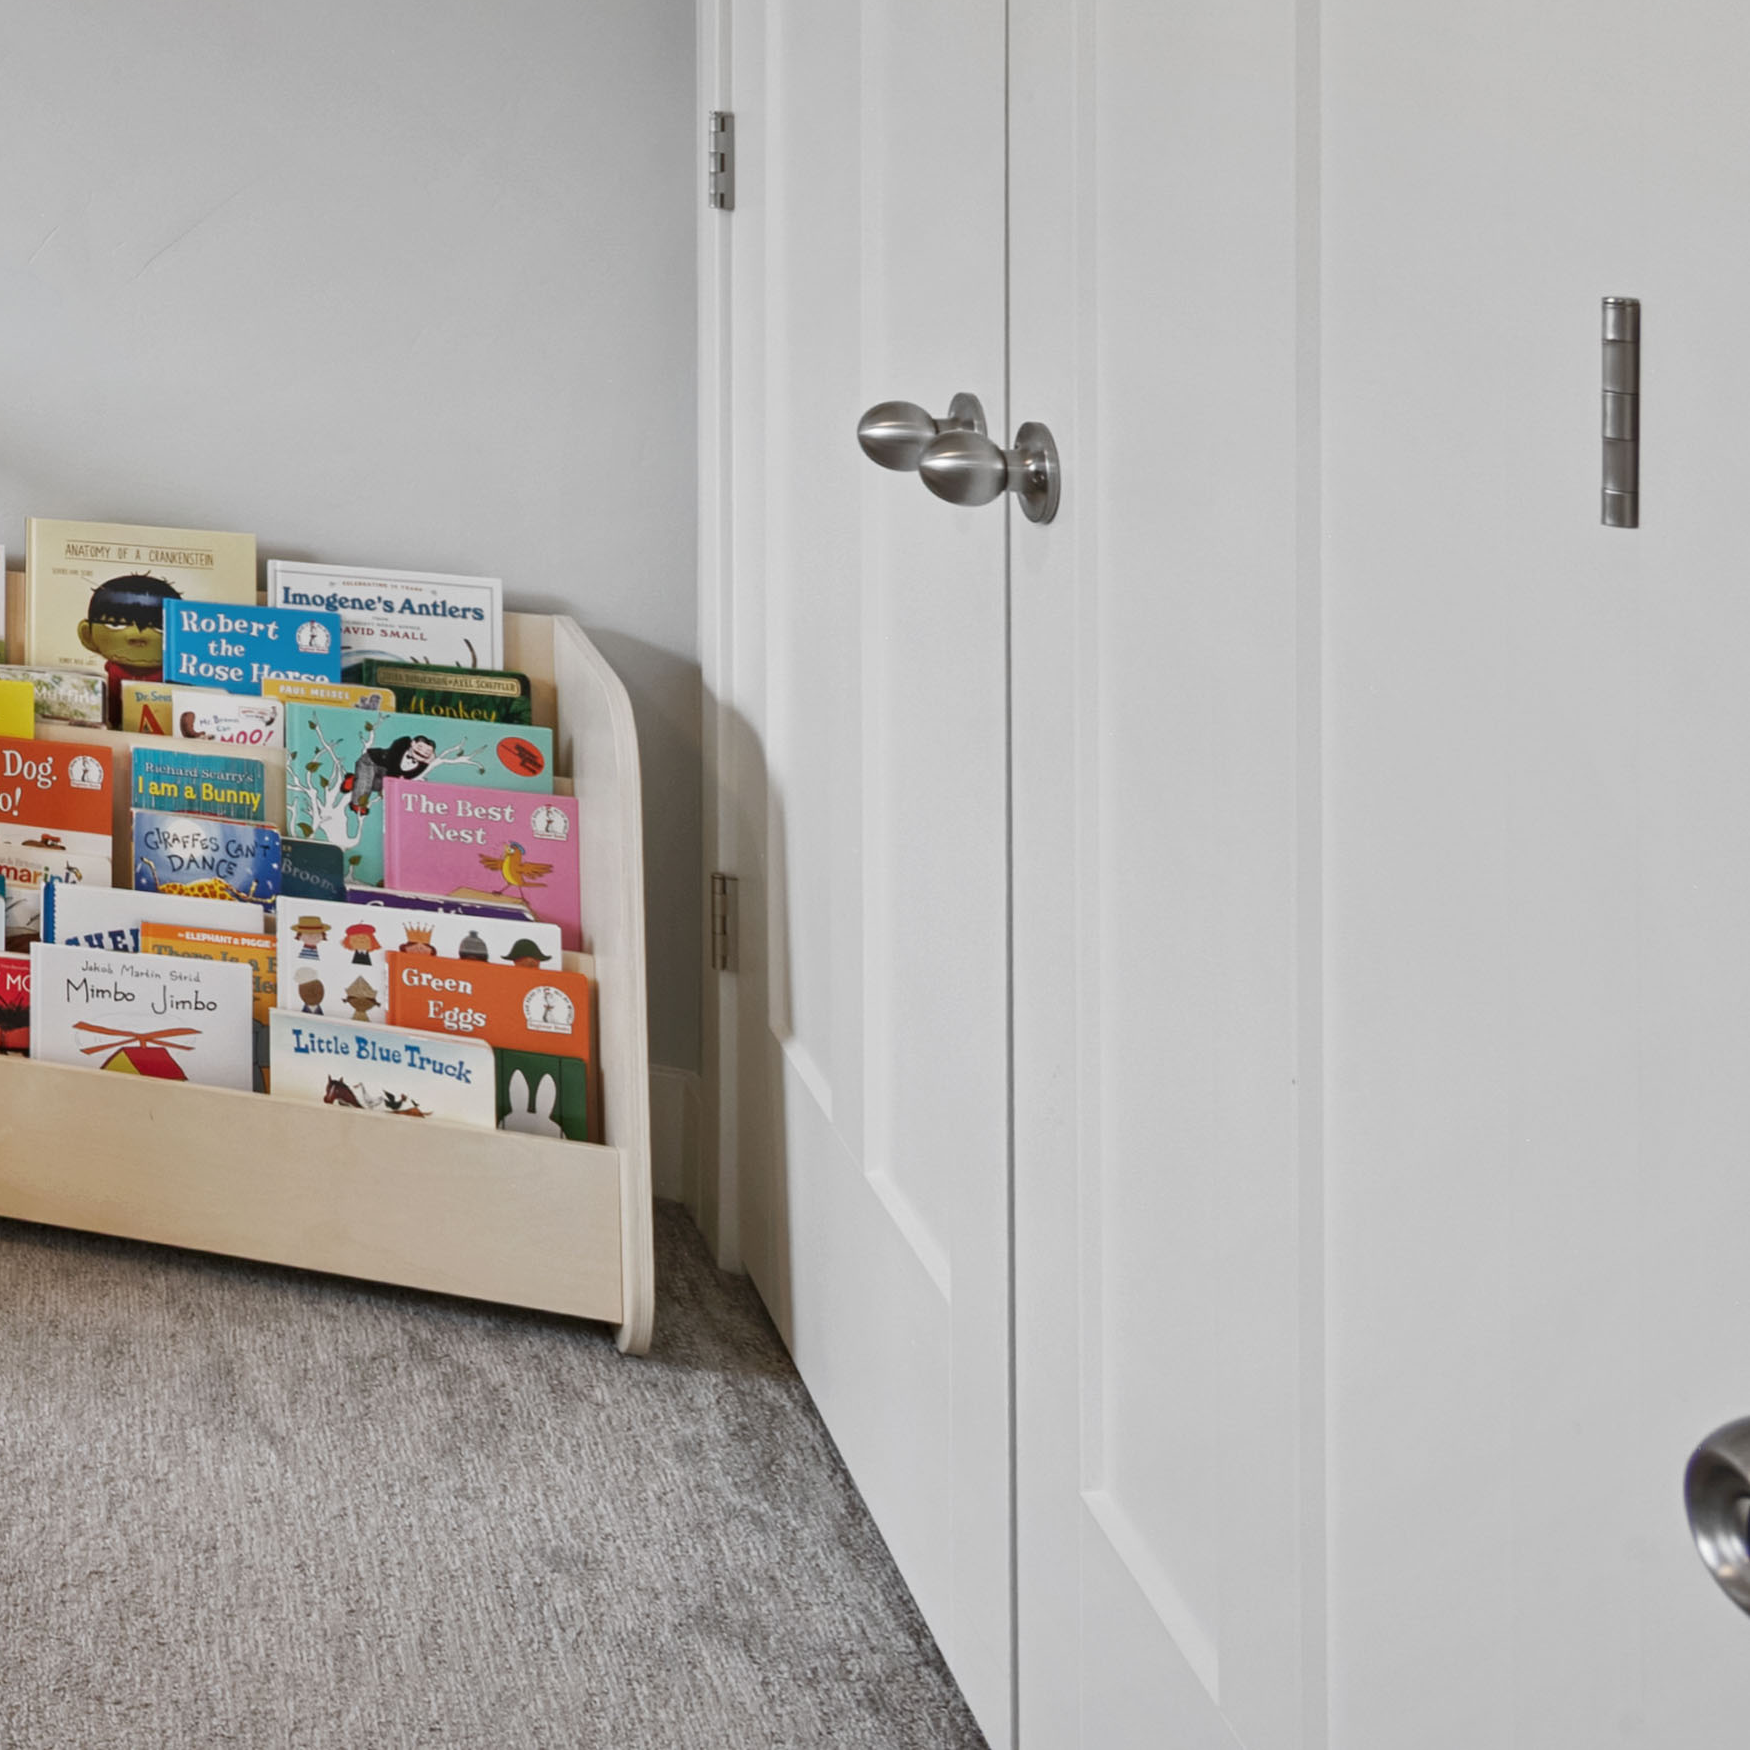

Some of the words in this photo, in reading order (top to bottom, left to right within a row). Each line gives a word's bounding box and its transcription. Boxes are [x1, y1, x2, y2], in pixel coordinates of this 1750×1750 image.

[64, 543, 110, 561] ANATOMY
[117, 546, 128, 560] OF
[134, 547, 141, 561] A
[149, 549, 213, 567] CRANKENSTEIN
[282, 586, 395, 613] Imogene's
[398, 598, 484, 621] Antlers
[179, 610, 279, 640] Robert
[341, 626, 375, 636] AVID
[380, 629, 428, 641] SMALL
[208, 638, 245, 657] the
[179, 652, 244, 682] Rose
[279, 684, 306, 697] PAUL
[409, 695, 497, 721] Monkey
[2, 749, 57, 789] Dog.
[144, 762, 198, 777] Richard
[201, 768, 254, 783] Scarry's
[137, 776, 144, 794] I
[148, 781, 178, 798] am
[184, 785, 196, 799] a
[201, 783, 261, 812] Bunny
[402, 793, 449, 815] The
[456, 800, 515, 823] Best
[144, 827, 220, 852] GIRAFFES
[225, 839, 271, 859] CAN'T
[429, 822, 487, 845] Nest
[167, 854, 238, 879] DANCE
[282, 859, 337, 893] Broom
[185, 931, 233, 945] ELEPHANT
[241, 936, 273, 949] PIGGIE
[81, 960, 113, 975] Jakob
[121, 964, 161, 979] Martin
[170, 970, 201, 983] Strid
[402, 967, 473, 995] Green
[66, 978, 136, 1003] Mimbo
[151, 985, 218, 1014] Jimbo
[428, 1000, 487, 1033] Eggs
[292, 1028, 349, 1055] Little
[355, 1035, 402, 1064] Blue
[404, 1044, 472, 1084] Truck
